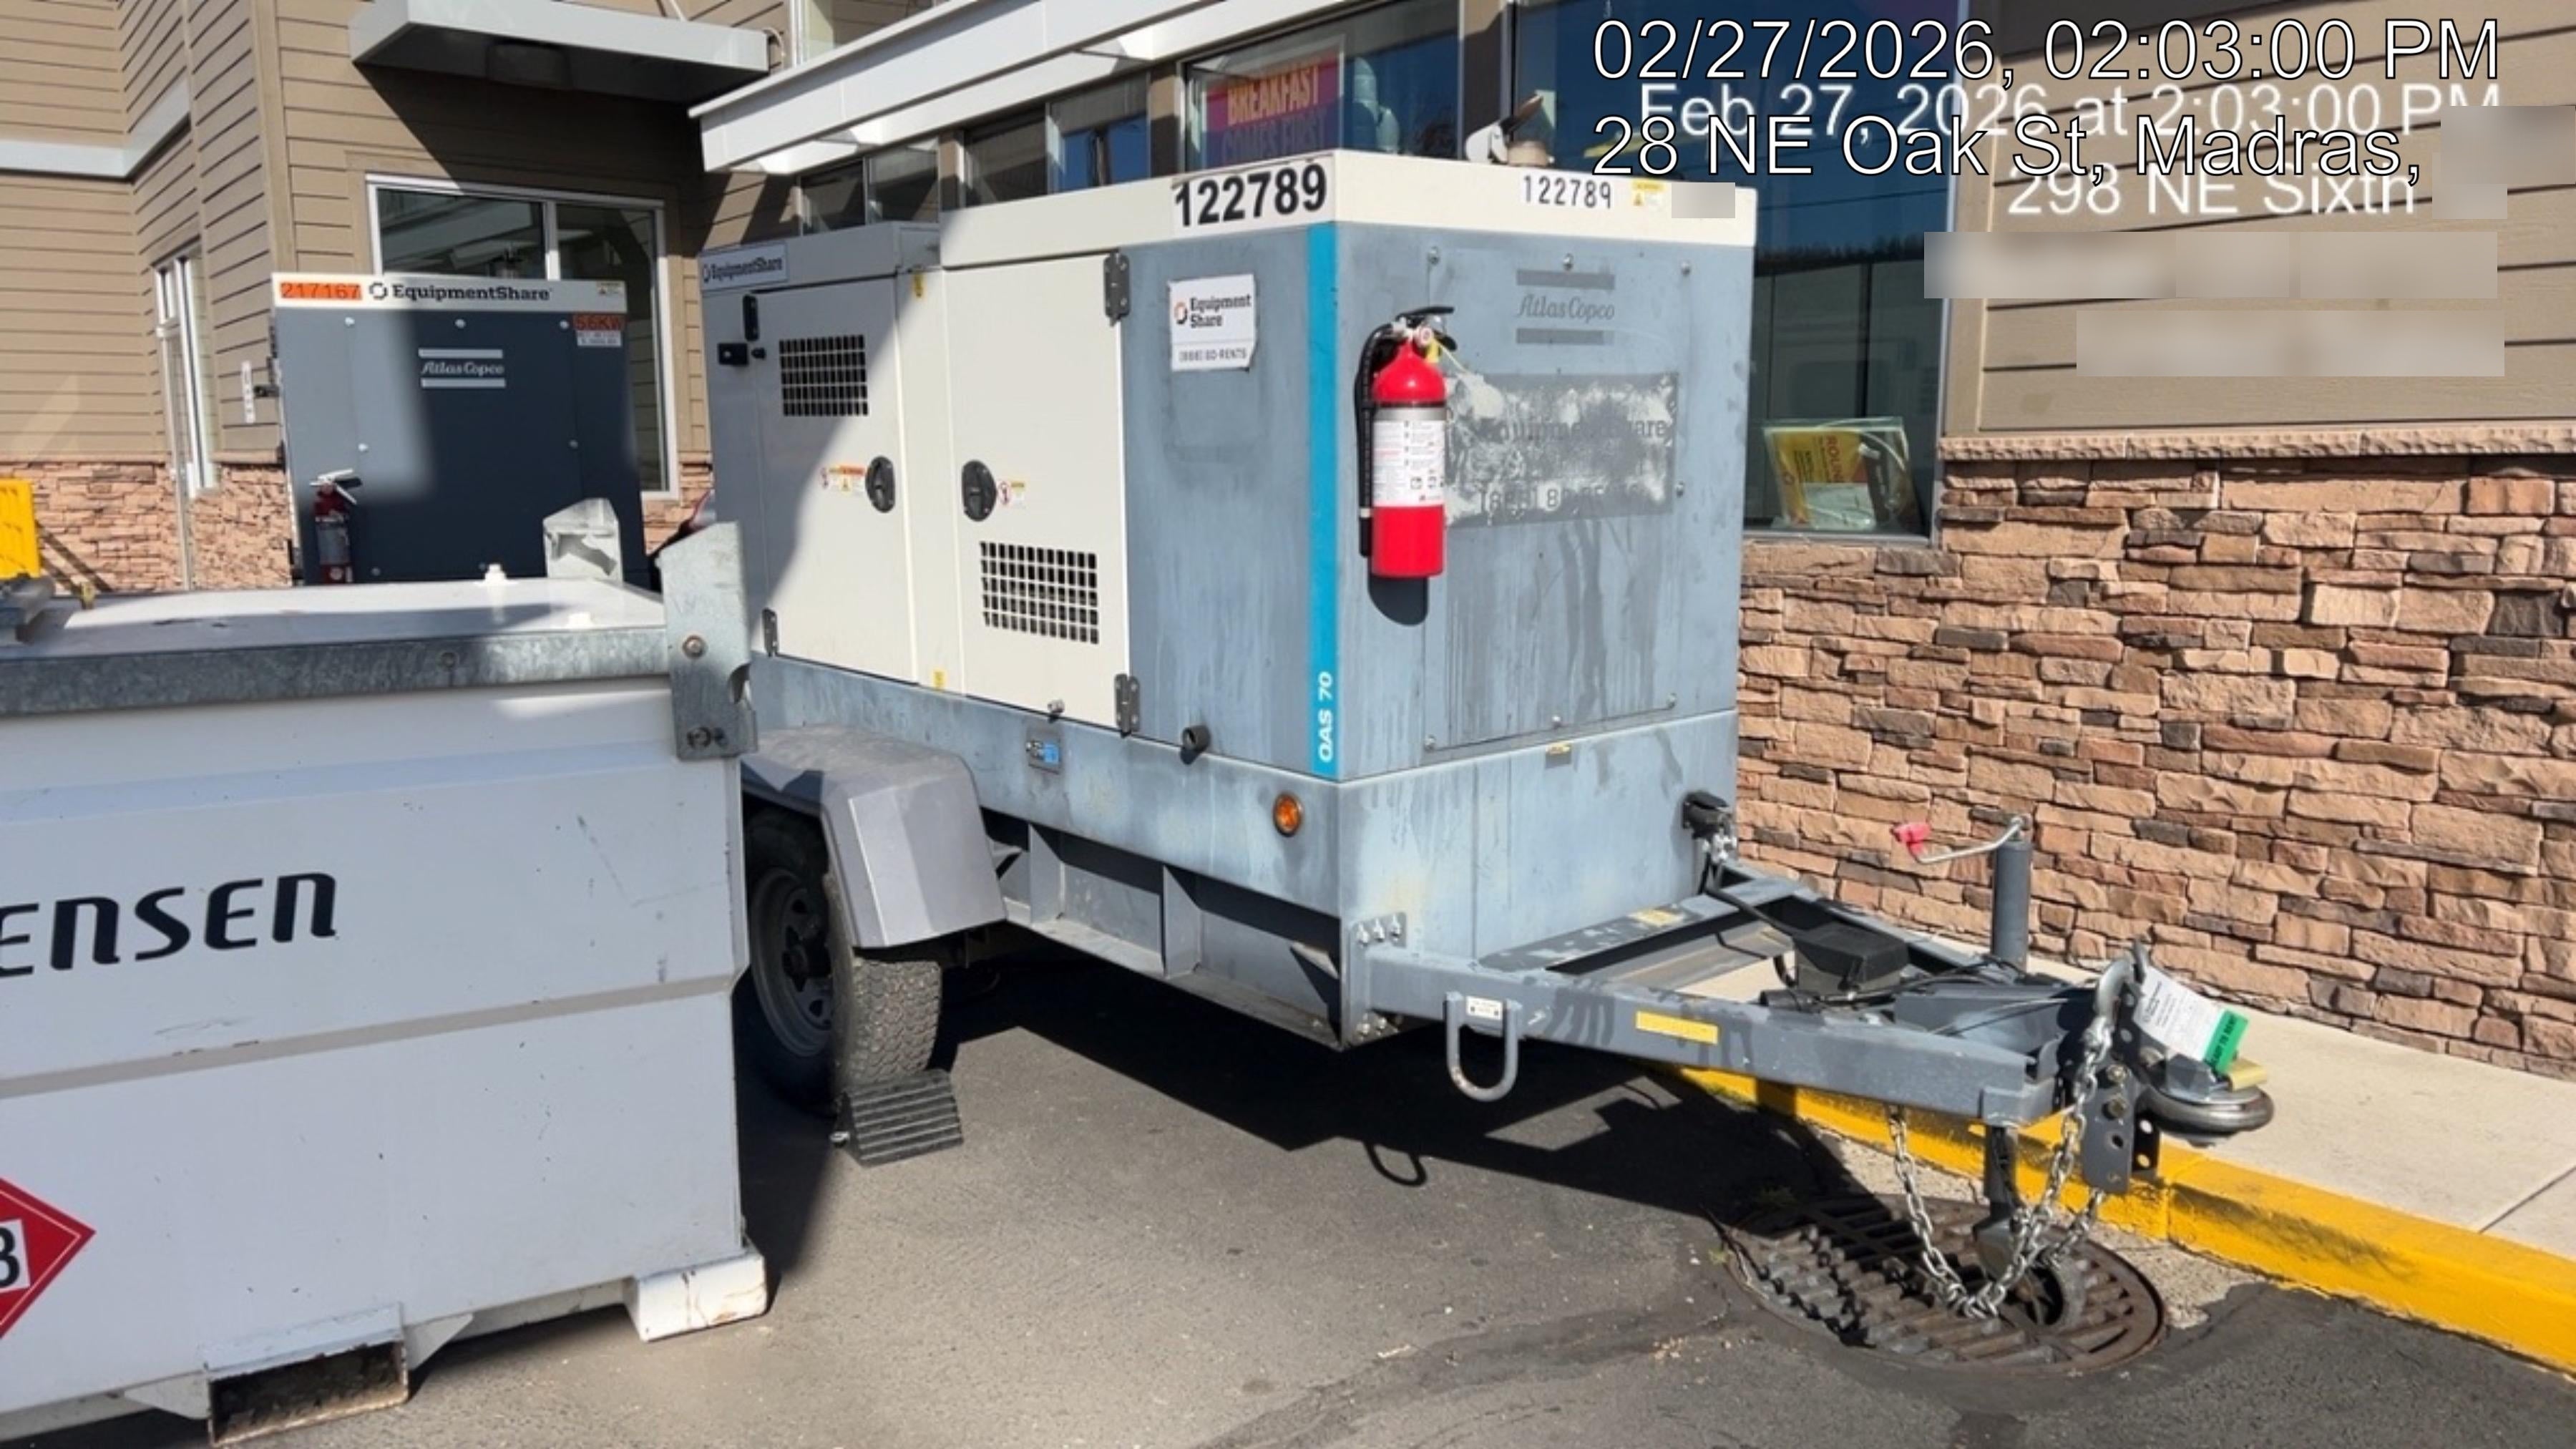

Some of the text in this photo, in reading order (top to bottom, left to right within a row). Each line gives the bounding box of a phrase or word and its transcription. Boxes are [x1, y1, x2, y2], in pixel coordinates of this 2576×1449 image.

[1227, 65, 1319, 127] BREAKFAST
[1175, 164, 1327, 227] 122789
[1523, 175, 1612, 210] 122789
[280, 282, 361, 300] 217167
[391, 284, 551, 303] EquipmentShare
[1190, 293, 1252, 313] Equipment
[1190, 313, 1222, 328] Share
[1318, 671, 1334, 701] 70
